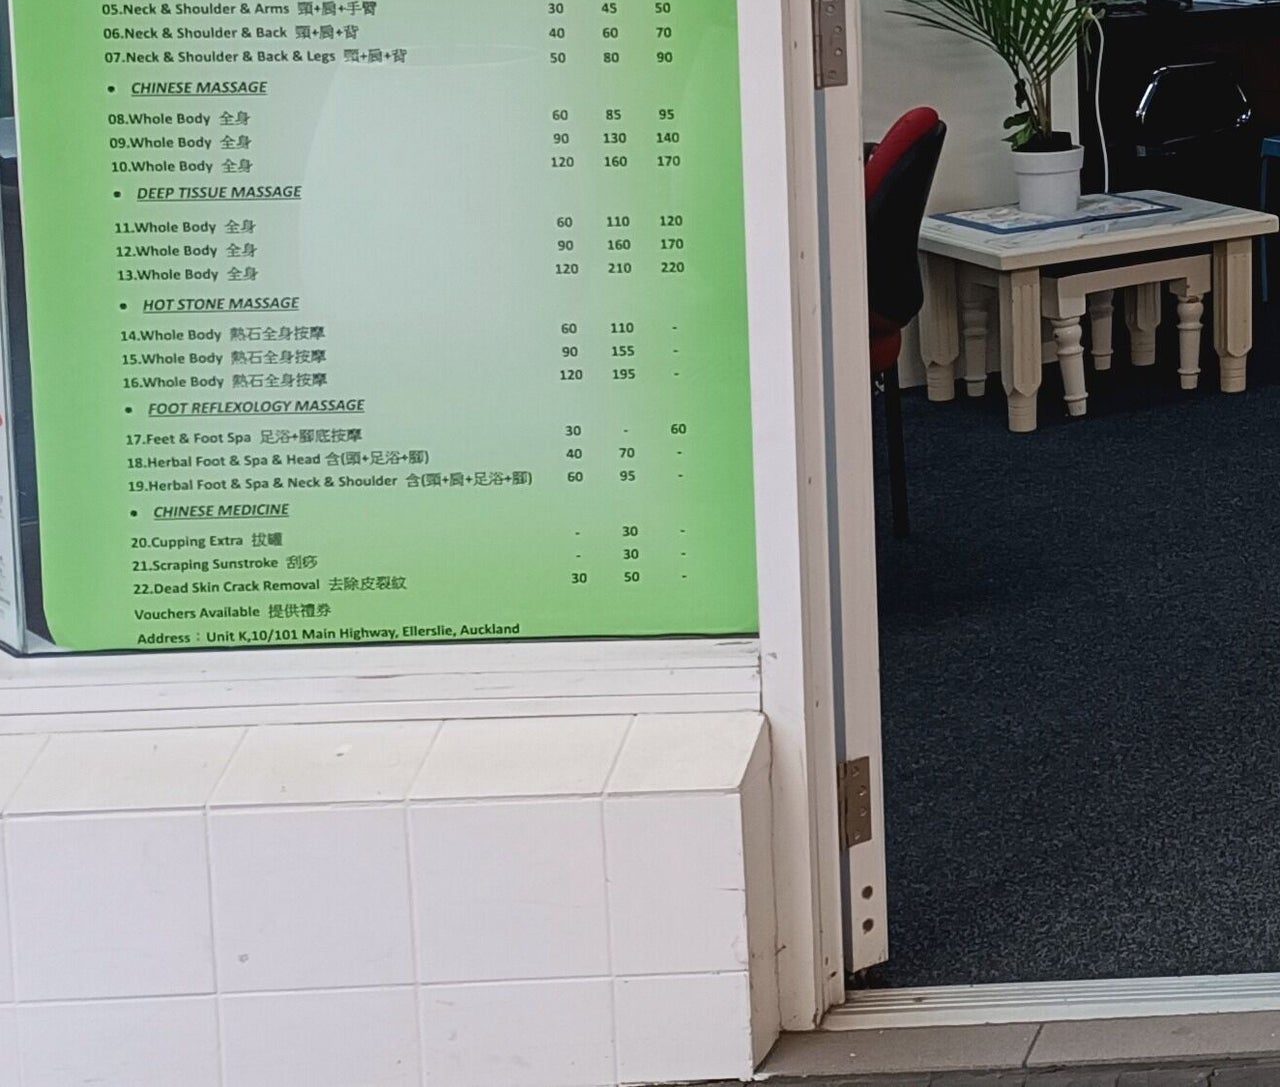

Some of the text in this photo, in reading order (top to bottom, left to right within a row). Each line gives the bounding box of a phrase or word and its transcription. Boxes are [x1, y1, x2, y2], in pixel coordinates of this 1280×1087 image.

[101, 3, 290, 15] 05.Neck & Shoulder & Arms
[548, 1, 672, 15] 30 45 50
[132, 81, 267, 94] CHINESE MASSAGE
[107, 111, 250, 126] 08.Whole Body 全身
[552, 108, 676, 121] 60 85 95
[137, 185, 302, 199] DEEP TISSUE MASSAGE
[114, 219, 256, 234] 11.Whole Body 全身
[556, 214, 684, 228] 60 110 120
[143, 297, 299, 311] HOT STONE MASSAGE
[561, 321, 635, 335] 60 110
[120, 329, 185, 340] 14.Whole
[187, 329, 222, 342] Body
[149, 399, 365, 414] FOOT REFLEXOLOGY MASSAGE
[565, 422, 688, 437] 30 60
[125, 434, 176, 445] 17.Feet
[178, 433, 190, 444] &
[193, 433, 225, 444] Foot
[226, 432, 252, 445] Spa
[566, 446, 636, 460] 40 70
[127, 454, 321, 468] 18.Herbal Foot & Spa & Head
[154, 503, 290, 518] CHINESE MEDICINE
[622, 525, 639, 538] 30
[130, 536, 207, 549] 20.Cupping
[209, 536, 244, 546] Extra
[571, 570, 641, 585] 30 50
[132, 582, 189, 594] 22.Dead
[191, 582, 220, 593] Skin
[222, 580, 260, 591] Crack
[262, 580, 321, 591] Removal
[134, 609, 196, 620] Vouchers
[199, 607, 260, 619] Available
[206, 632, 236, 643] Unit
[302, 629, 336, 640] Main
[340, 627, 399, 641] Highway,
[402, 626, 456, 638] Ellerslie,
[460, 624, 520, 636] Auckland
